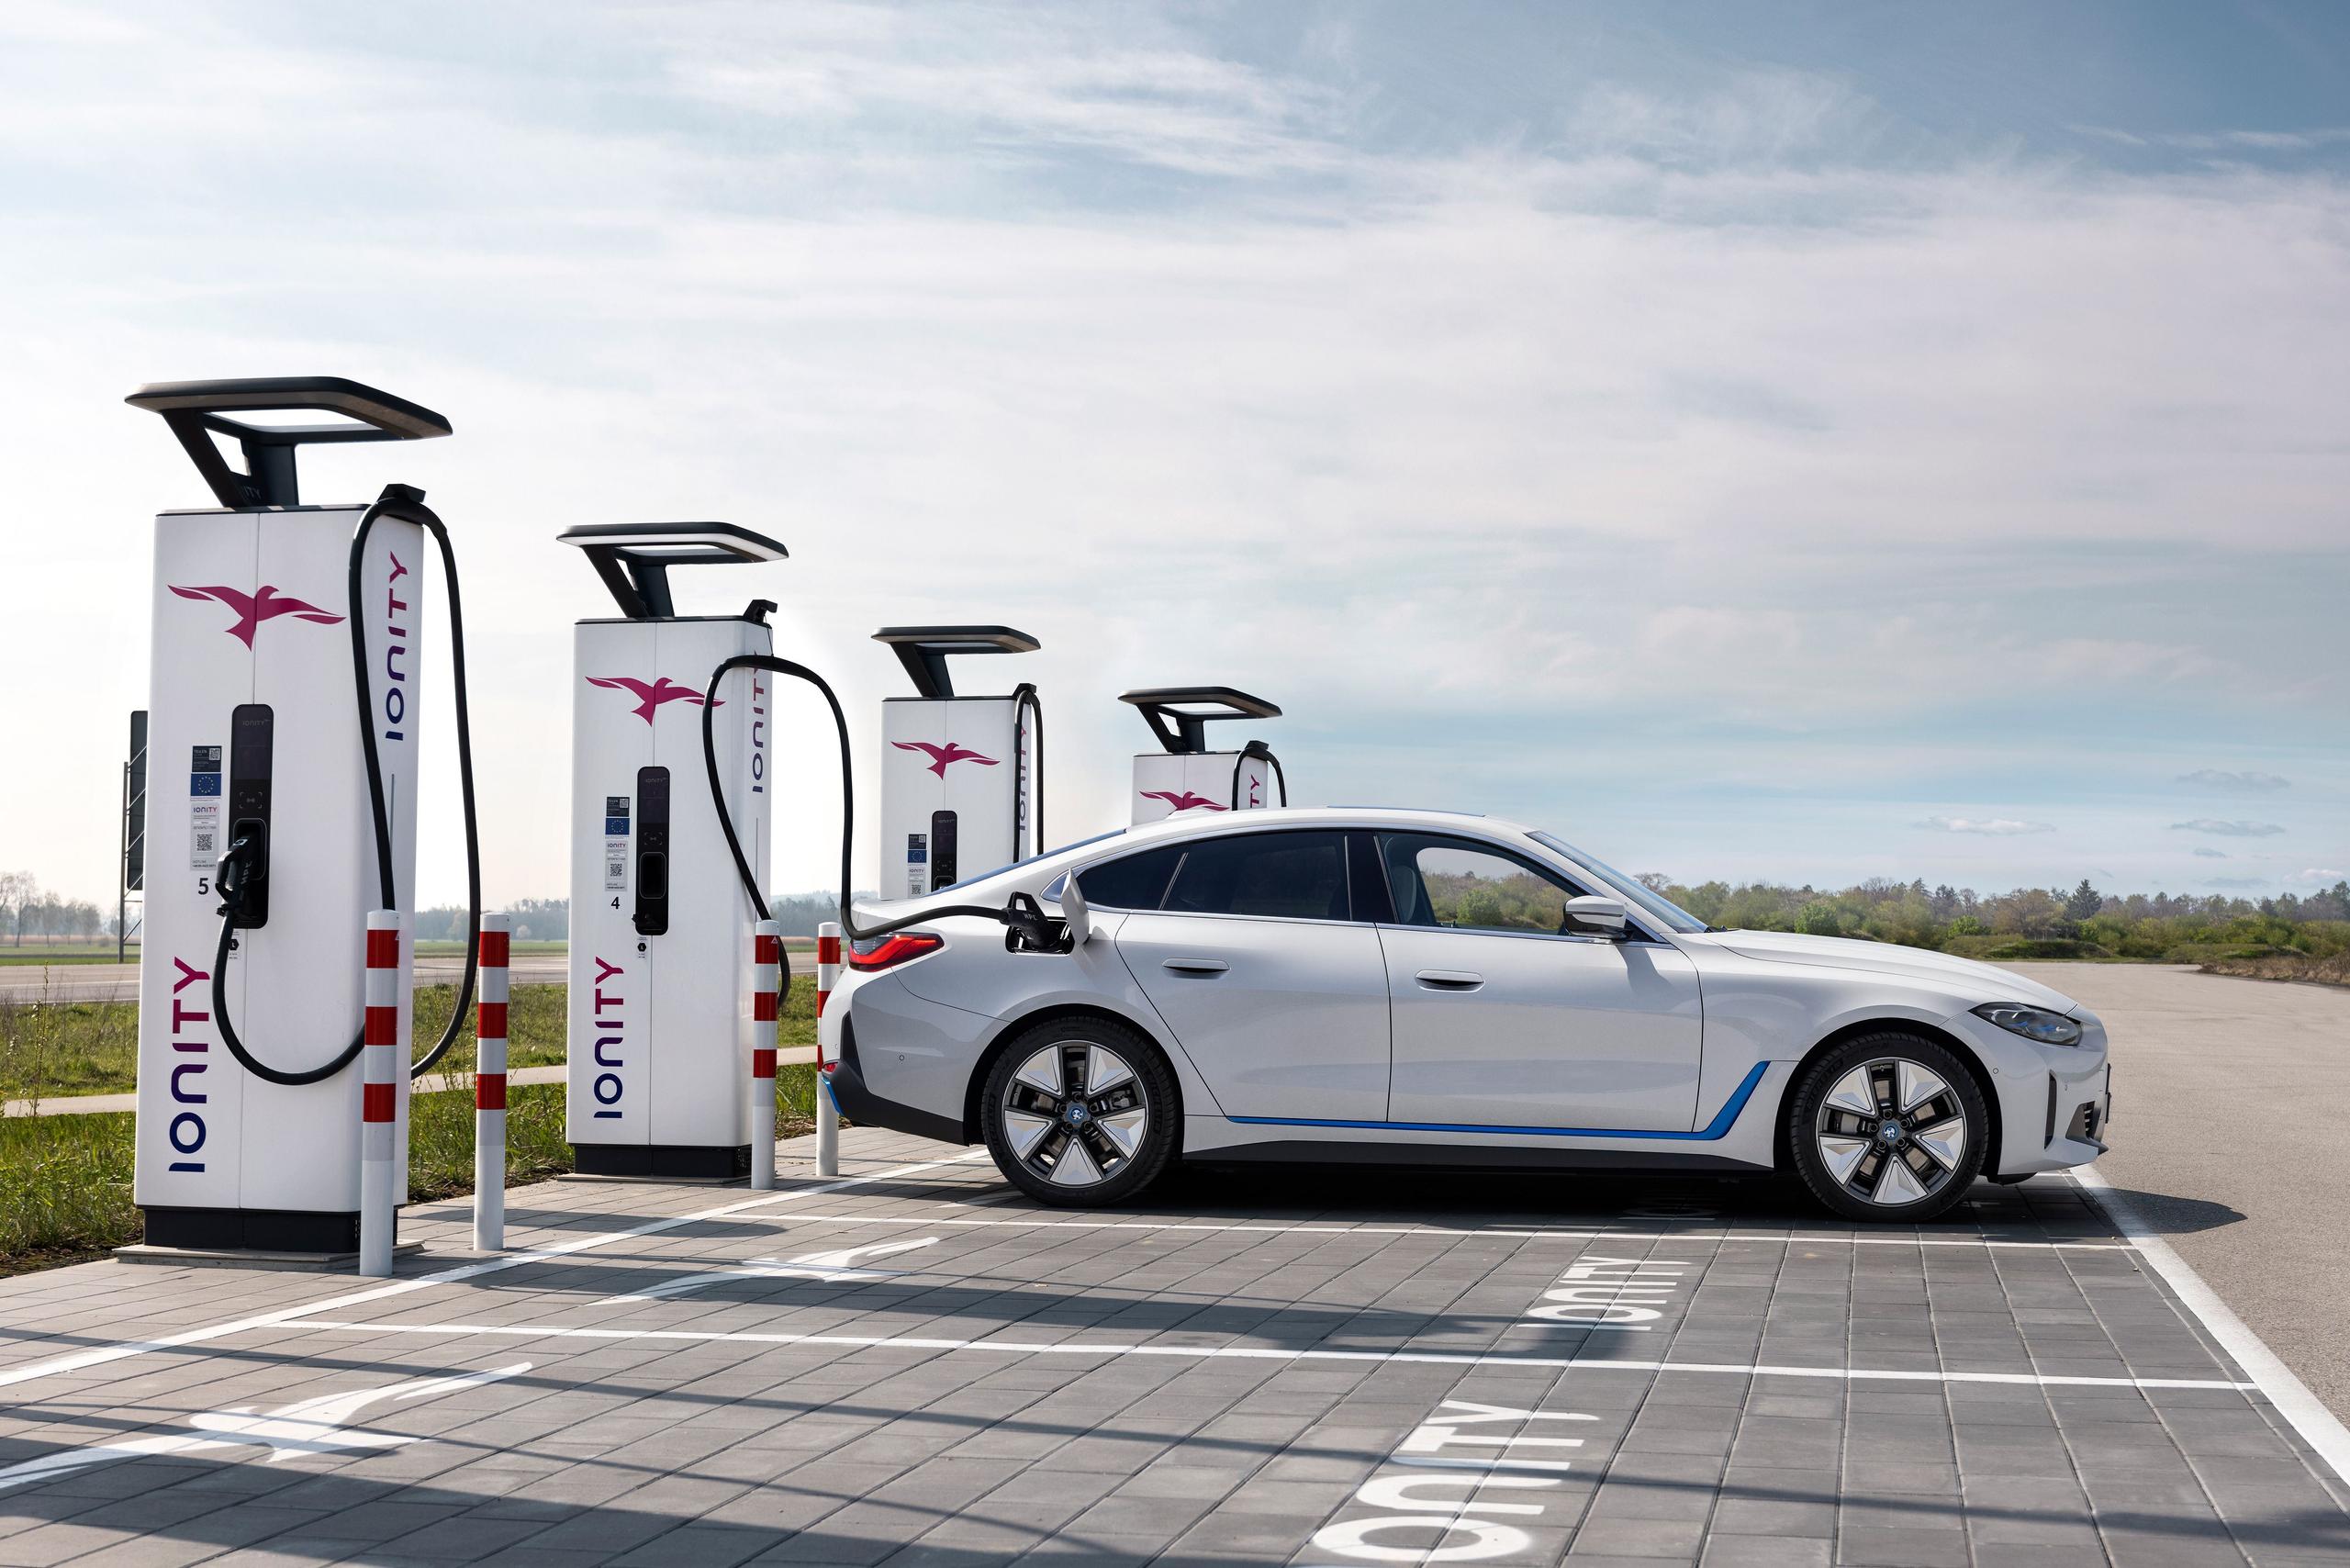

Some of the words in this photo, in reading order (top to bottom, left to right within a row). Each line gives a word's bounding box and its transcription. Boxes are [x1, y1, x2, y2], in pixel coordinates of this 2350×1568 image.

[386, 551, 408, 742] IONITY
[197, 878, 209, 895] 5
[610, 896, 621, 910] 4
[169, 957, 210, 1172] IONITY
[593, 956, 624, 1118] IONITY
[1516, 1256, 1692, 1331] IONITY
[1294, 1400, 1600, 1568] ONITY
